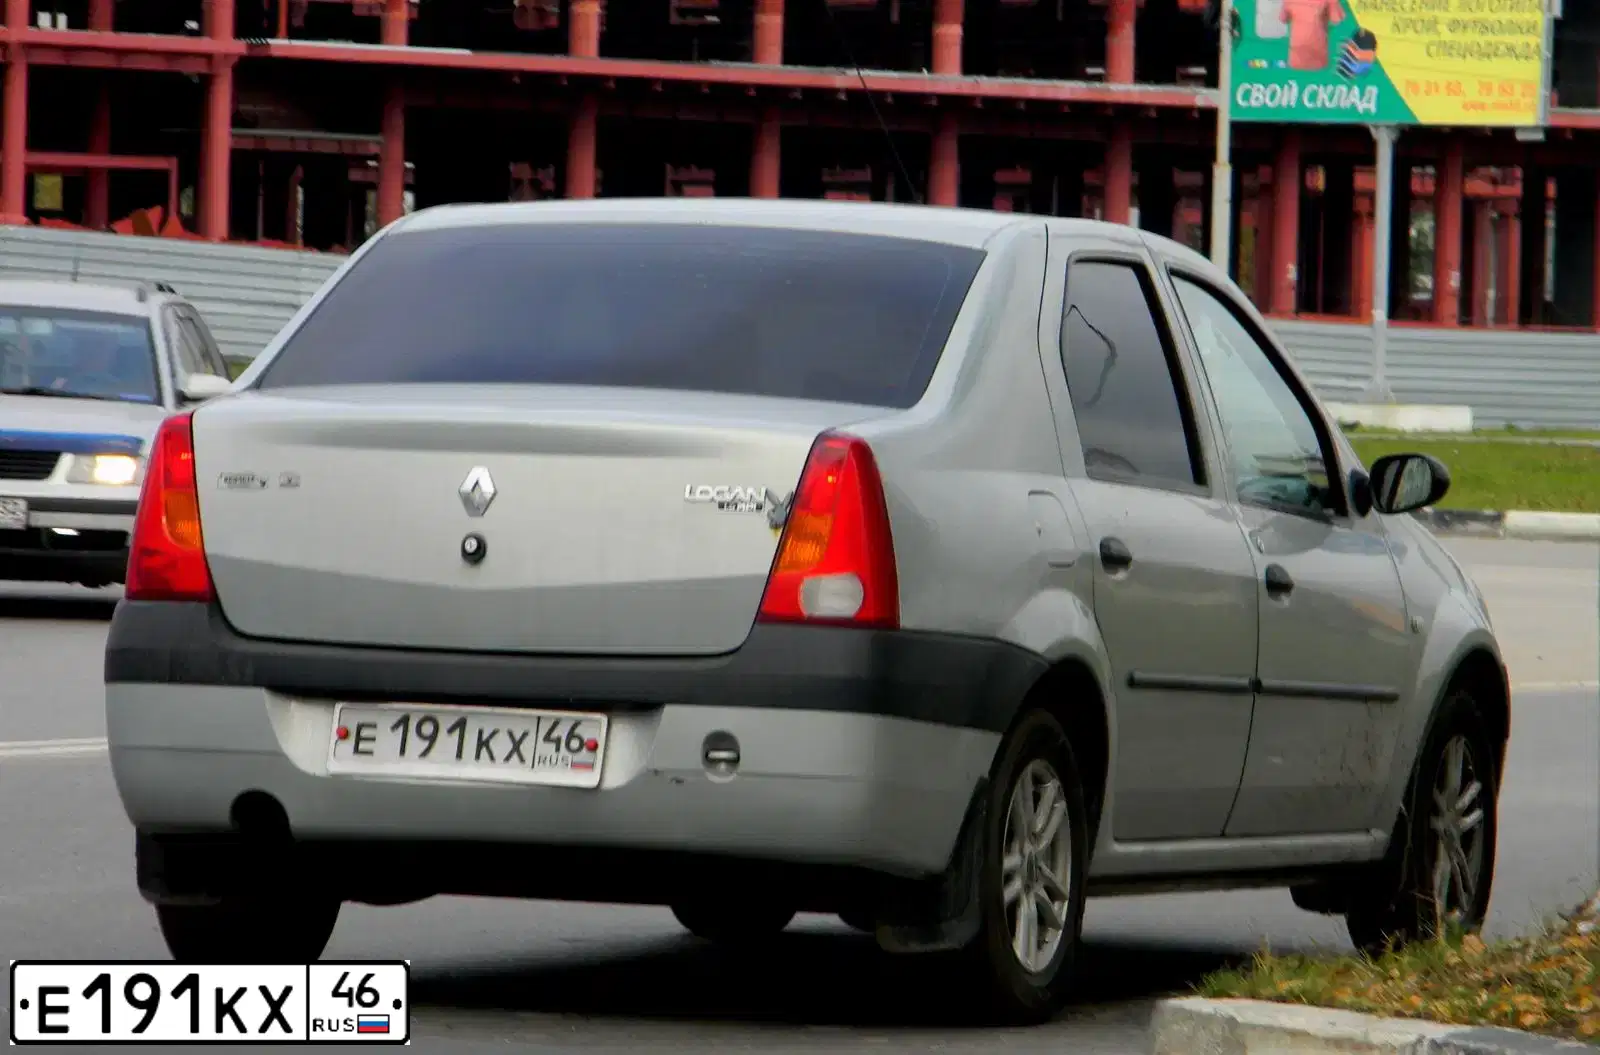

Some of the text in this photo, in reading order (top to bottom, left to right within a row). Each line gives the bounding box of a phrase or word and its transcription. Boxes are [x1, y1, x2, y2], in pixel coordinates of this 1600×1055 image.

[1236, 79, 1378, 114] СВОЙ СКЛАД
[684, 484, 766, 502] LOGAN
[537, 754, 570, 769] RUS
